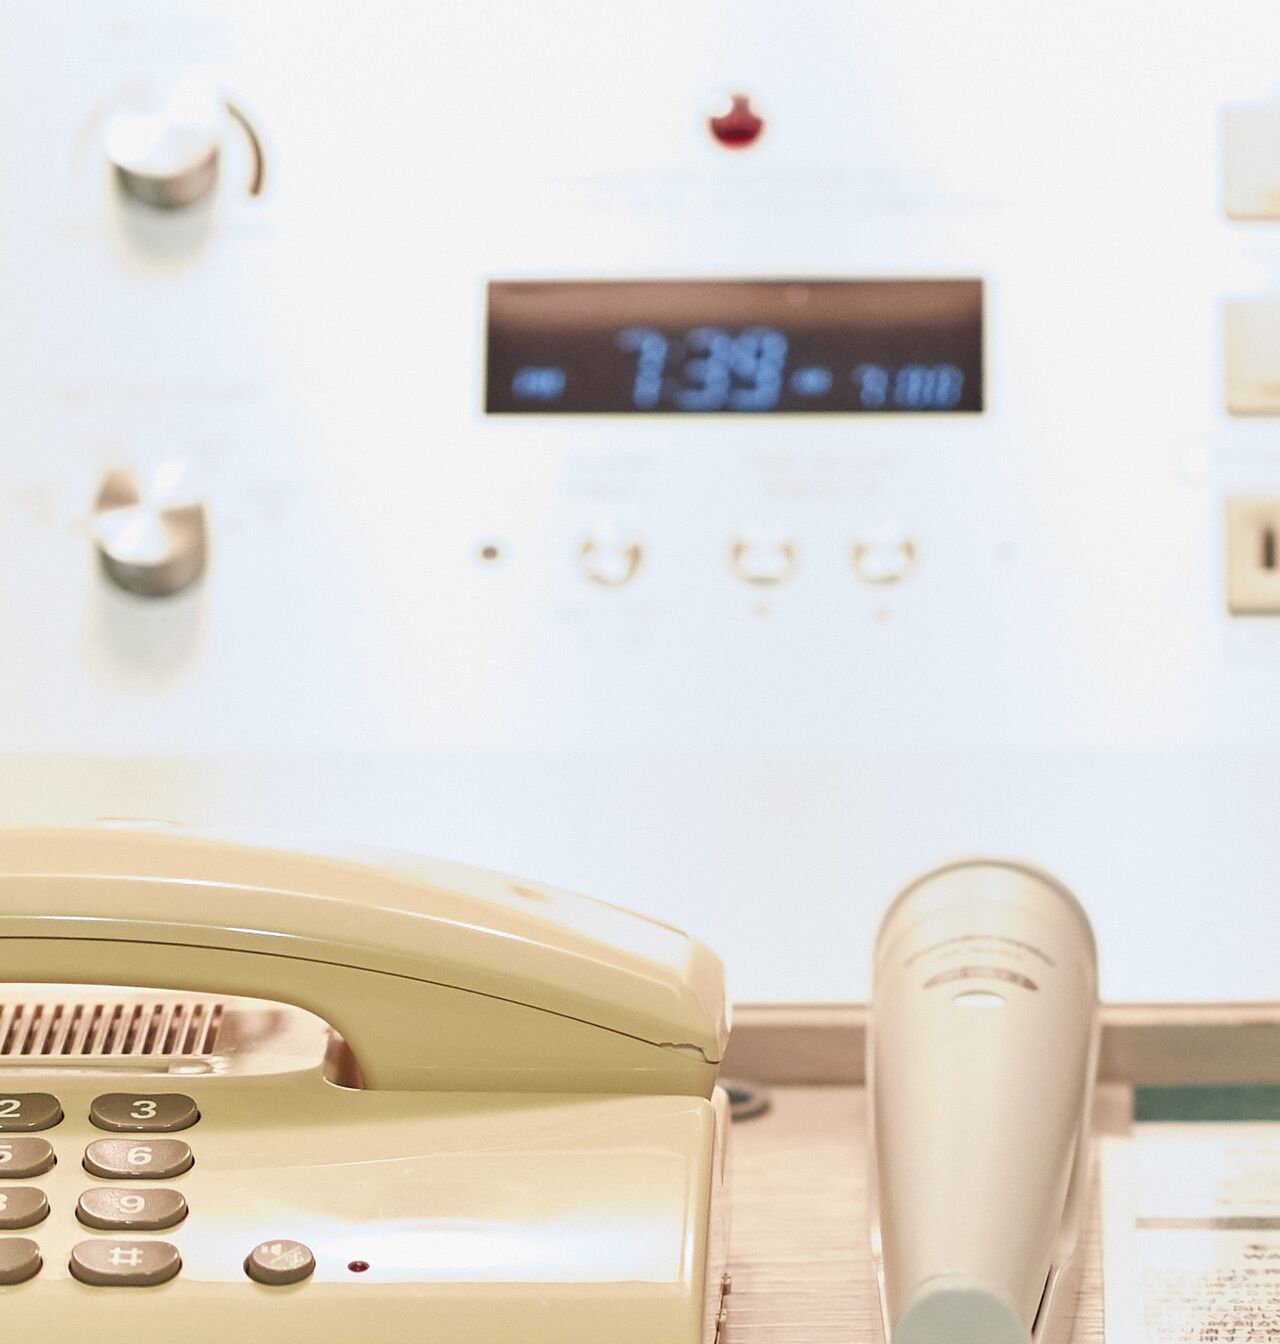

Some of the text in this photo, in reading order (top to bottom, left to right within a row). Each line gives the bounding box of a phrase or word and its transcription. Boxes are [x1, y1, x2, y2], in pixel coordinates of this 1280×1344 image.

[130, 1100, 157, 1119] 3
[126, 1146, 153, 1165] 6
[119, 1194, 145, 1213] 9
